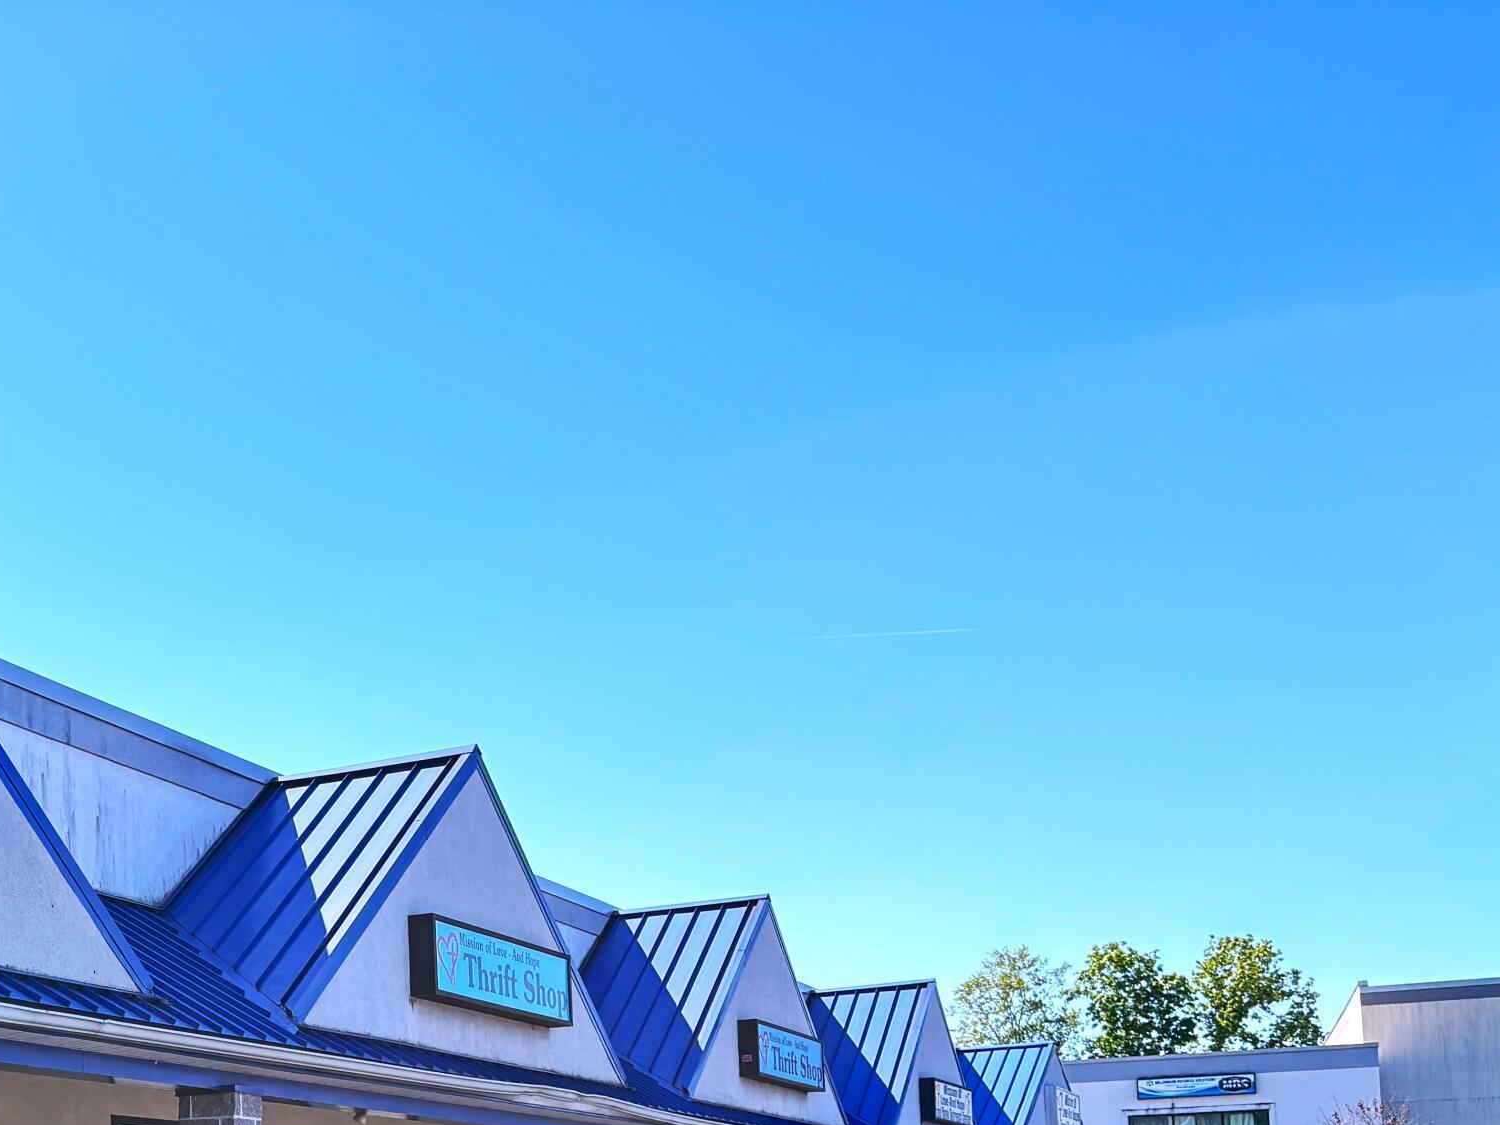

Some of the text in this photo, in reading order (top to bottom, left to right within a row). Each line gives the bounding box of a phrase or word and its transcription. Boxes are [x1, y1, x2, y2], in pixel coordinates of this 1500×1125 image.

[459, 932, 484, 952] Mission
[485, 941, 493, 954] of
[493, 942, 508, 959] Love
[512, 948, 524, 963] And
[525, 952, 541, 970] Hope
[463, 952, 568, 1018] Thrift Shop
[771, 1046, 823, 1088] Thrift Shop
[1222, 1079, 1249, 1089] MBS
